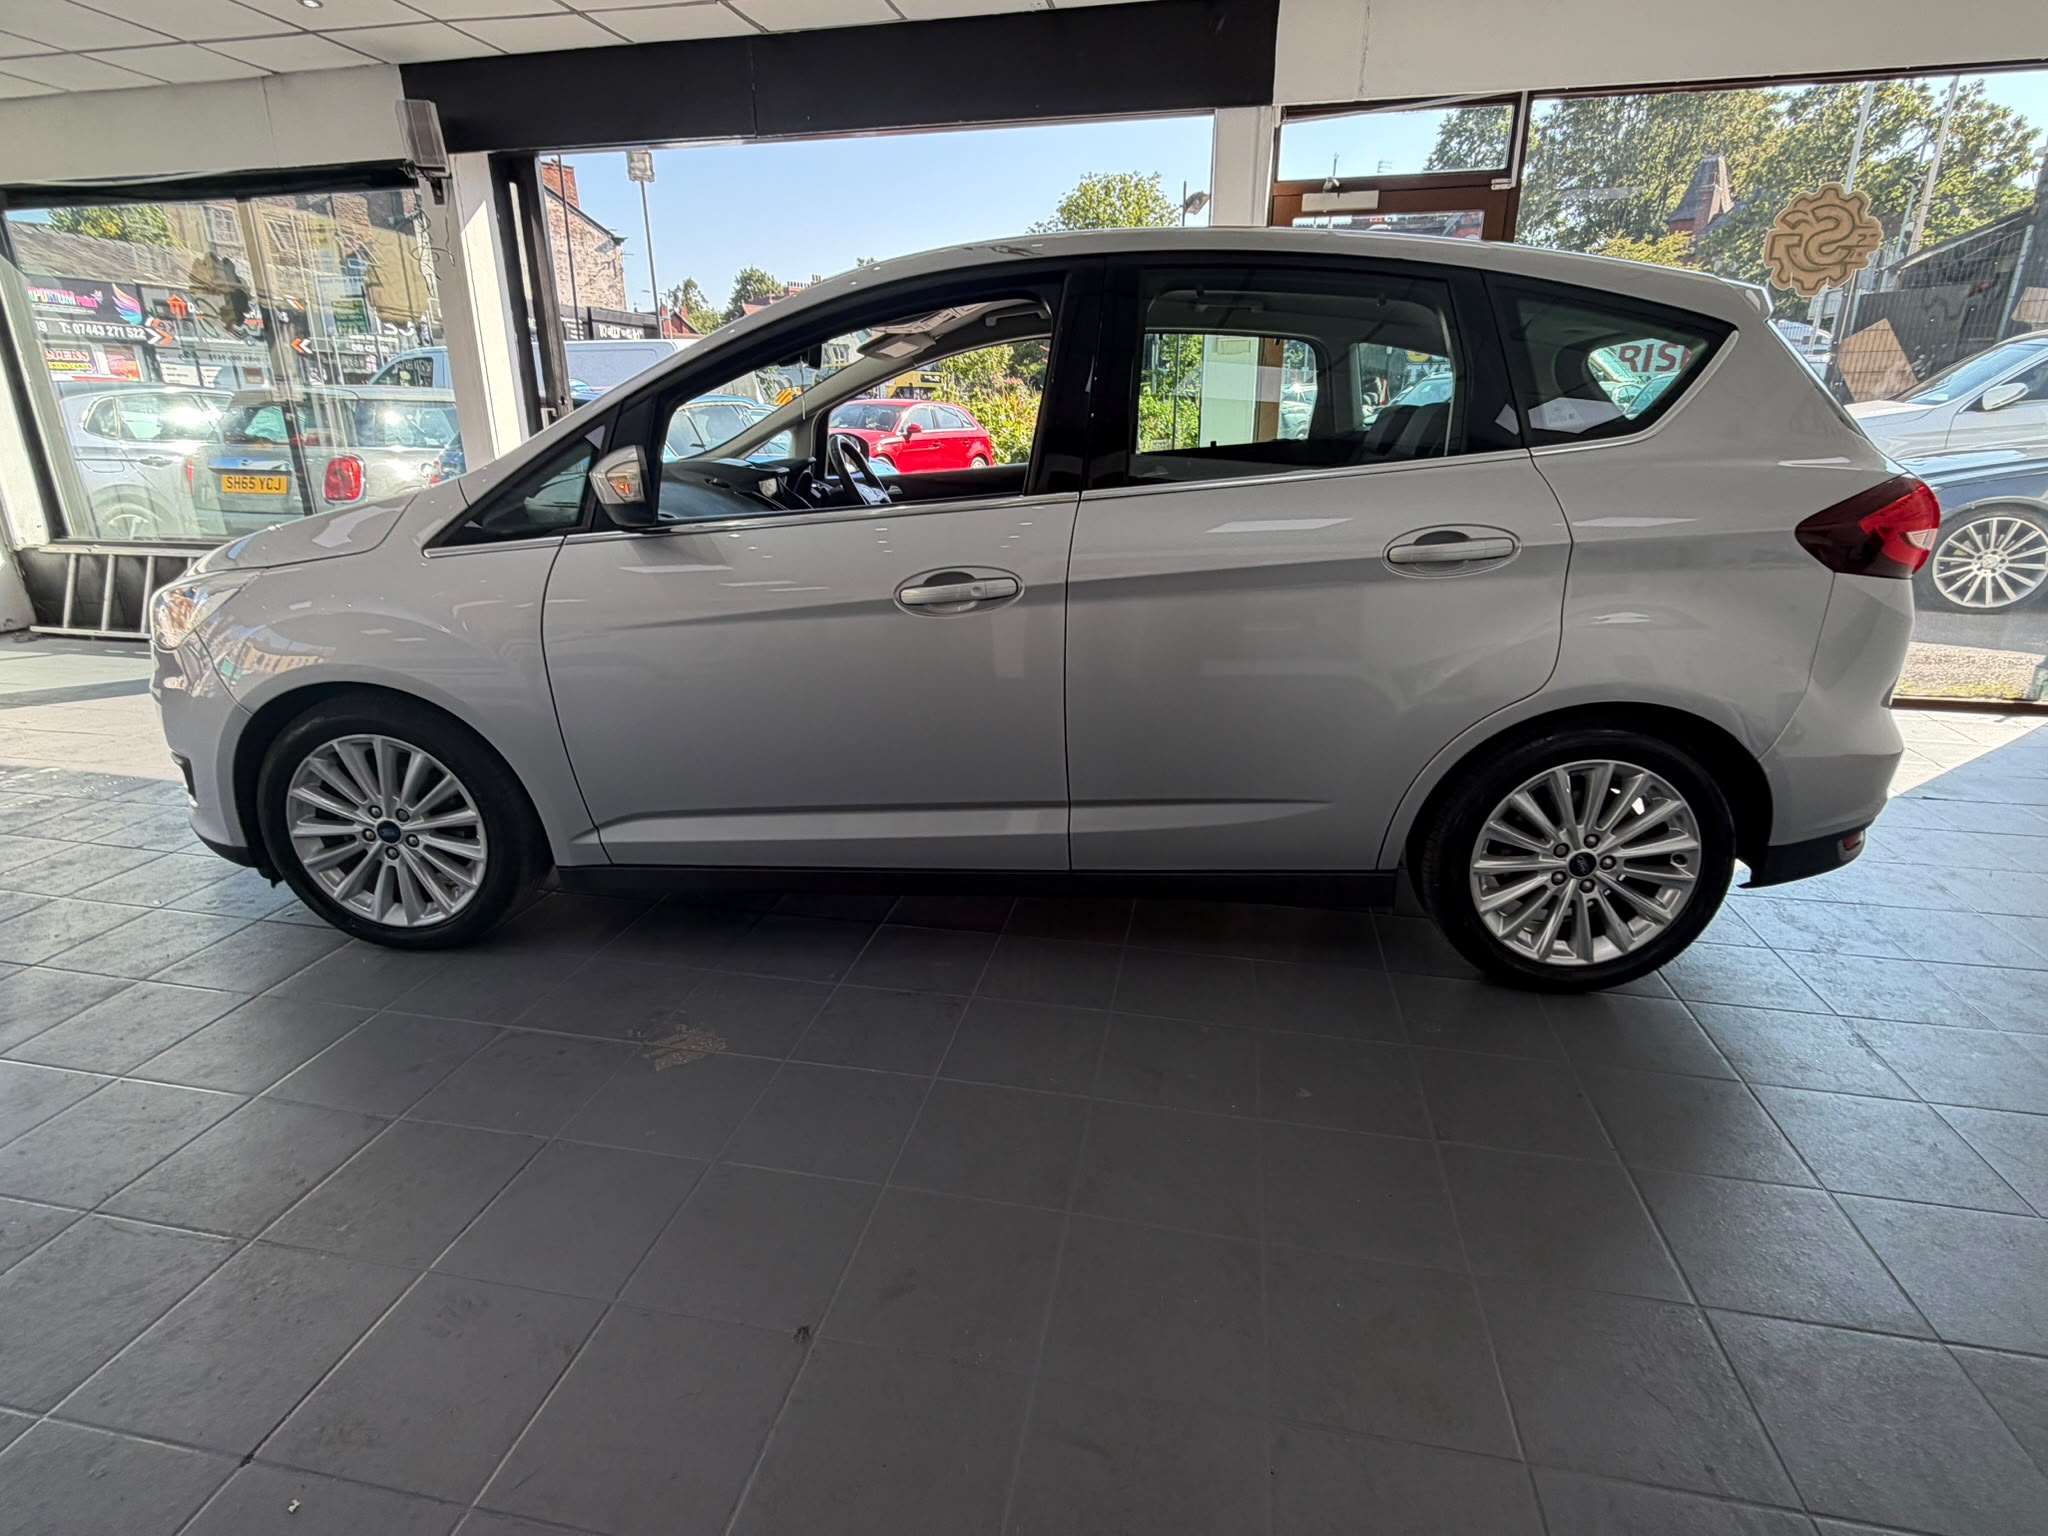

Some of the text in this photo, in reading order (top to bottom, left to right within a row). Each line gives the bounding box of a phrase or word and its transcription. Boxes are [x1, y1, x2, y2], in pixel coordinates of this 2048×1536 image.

[73, 323, 105, 336] 07443
[106, 326, 125, 337] 271
[126, 330, 147, 340] 522
[226, 476, 282, 491] SH65 YCJ
